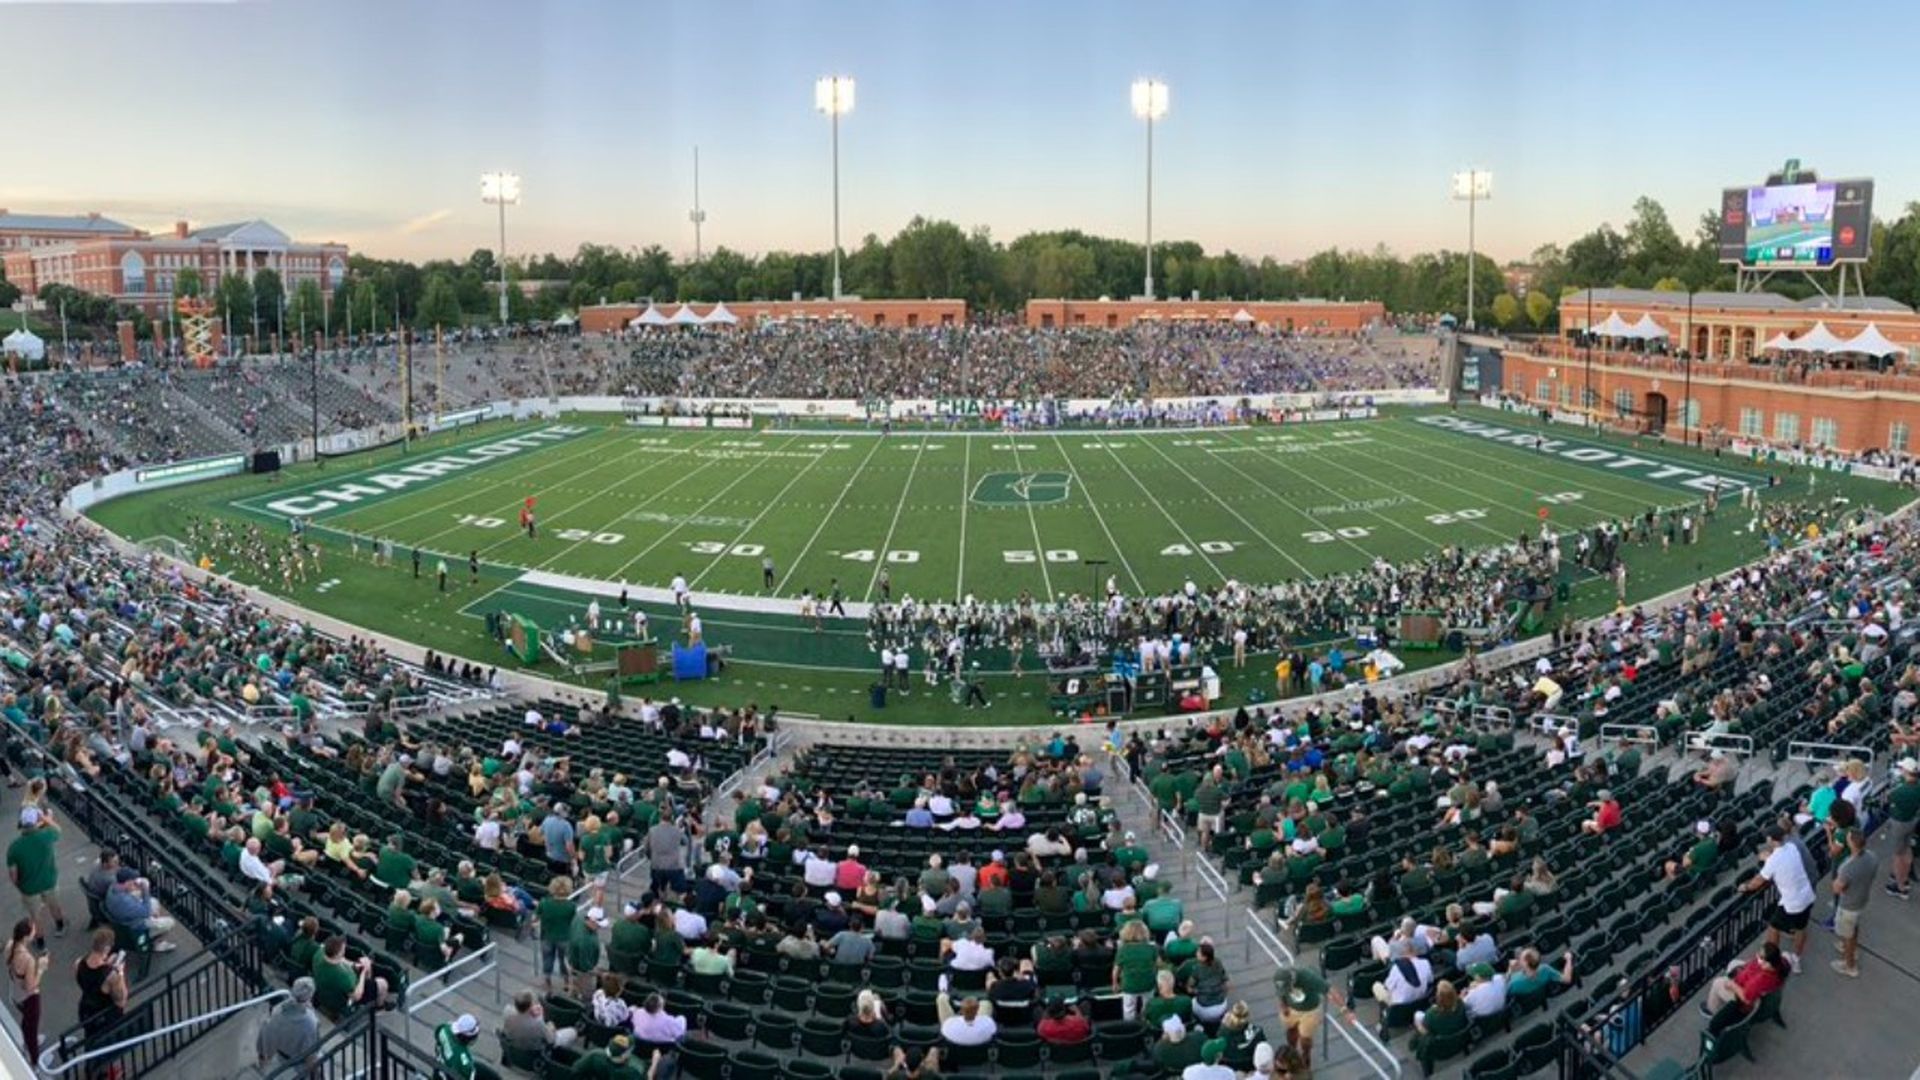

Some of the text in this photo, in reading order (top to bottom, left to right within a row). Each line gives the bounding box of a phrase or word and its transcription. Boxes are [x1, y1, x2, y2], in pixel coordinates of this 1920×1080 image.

[1415, 415, 1749, 491] CHARLOTTE
[266, 424, 588, 516] CHARLOTTE
[457, 514, 506, 528] 10
[1425, 508, 1487, 525] 20
[555, 528, 626, 544] 20
[1301, 526, 1371, 543] 30
[691, 541, 765, 556] 30
[841, 549, 920, 563] 40
[1160, 541, 1235, 556] 40
[1002, 550, 1079, 563] 50
